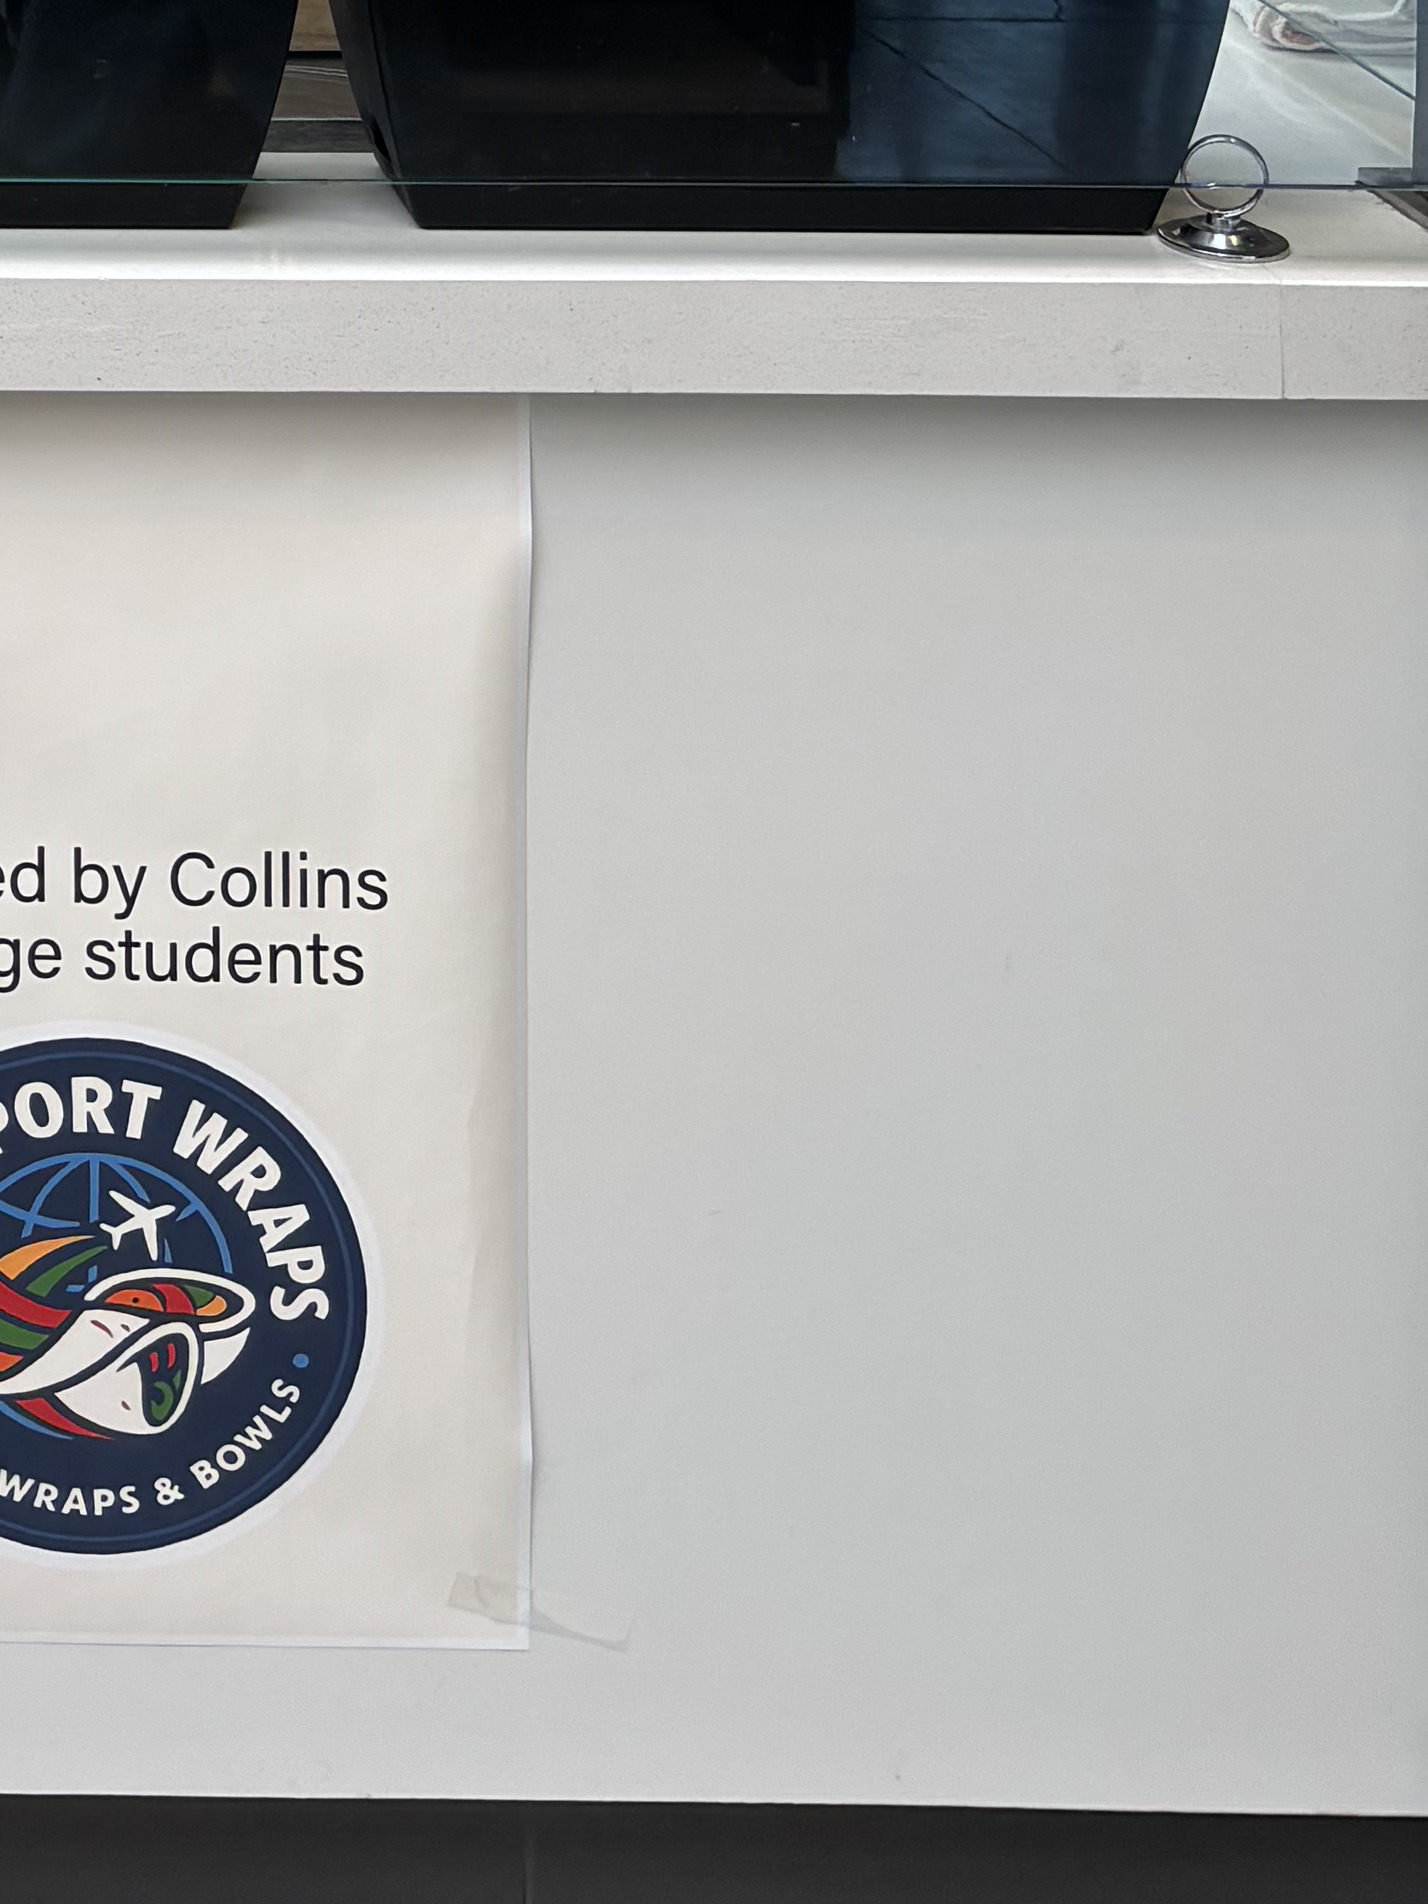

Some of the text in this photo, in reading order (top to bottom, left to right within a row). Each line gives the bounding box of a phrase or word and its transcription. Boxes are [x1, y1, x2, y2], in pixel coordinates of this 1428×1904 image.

[74, 846, 147, 920] by
[170, 851, 388, 911] Collins
[85, 926, 364, 987] students
[172, 1099, 331, 1323] WRAPS
[154, 1475, 185, 1506] &
[189, 1377, 301, 1490] BOWLS
